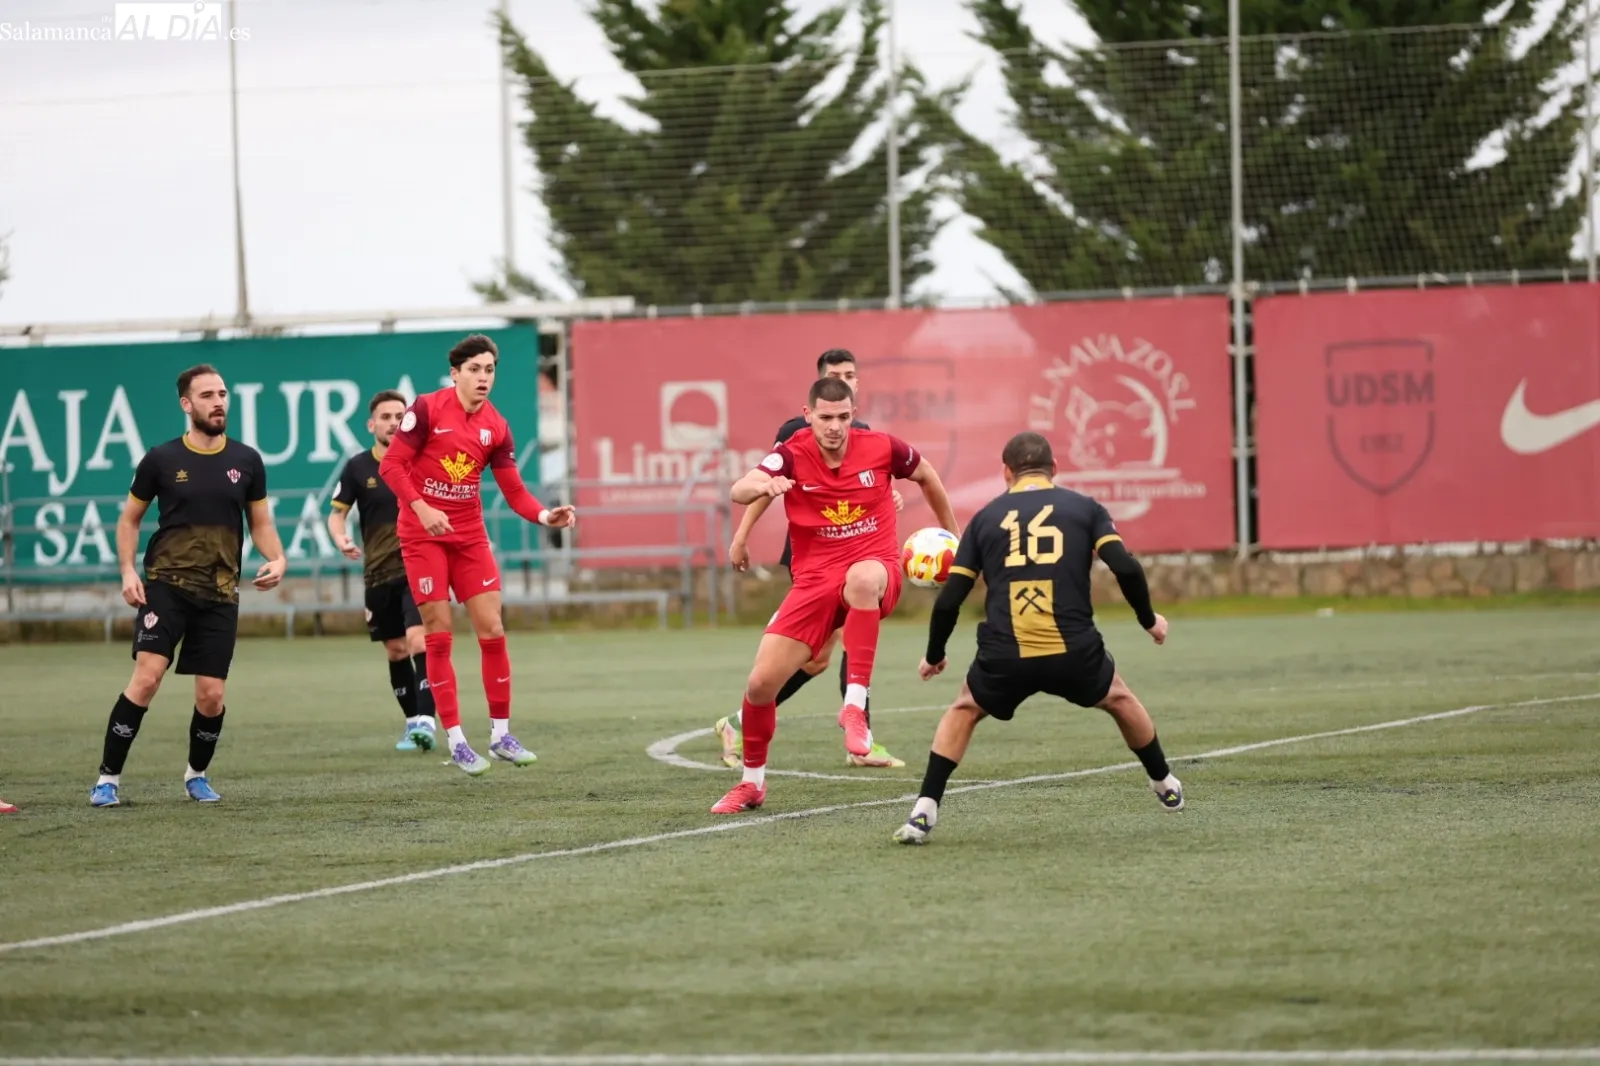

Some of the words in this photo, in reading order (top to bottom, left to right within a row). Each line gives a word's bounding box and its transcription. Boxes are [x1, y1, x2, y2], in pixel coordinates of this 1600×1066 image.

[1326, 370, 1435, 408] UDSM
[0, 384, 147, 496] AJA
[1000, 504, 1063, 568] 16
